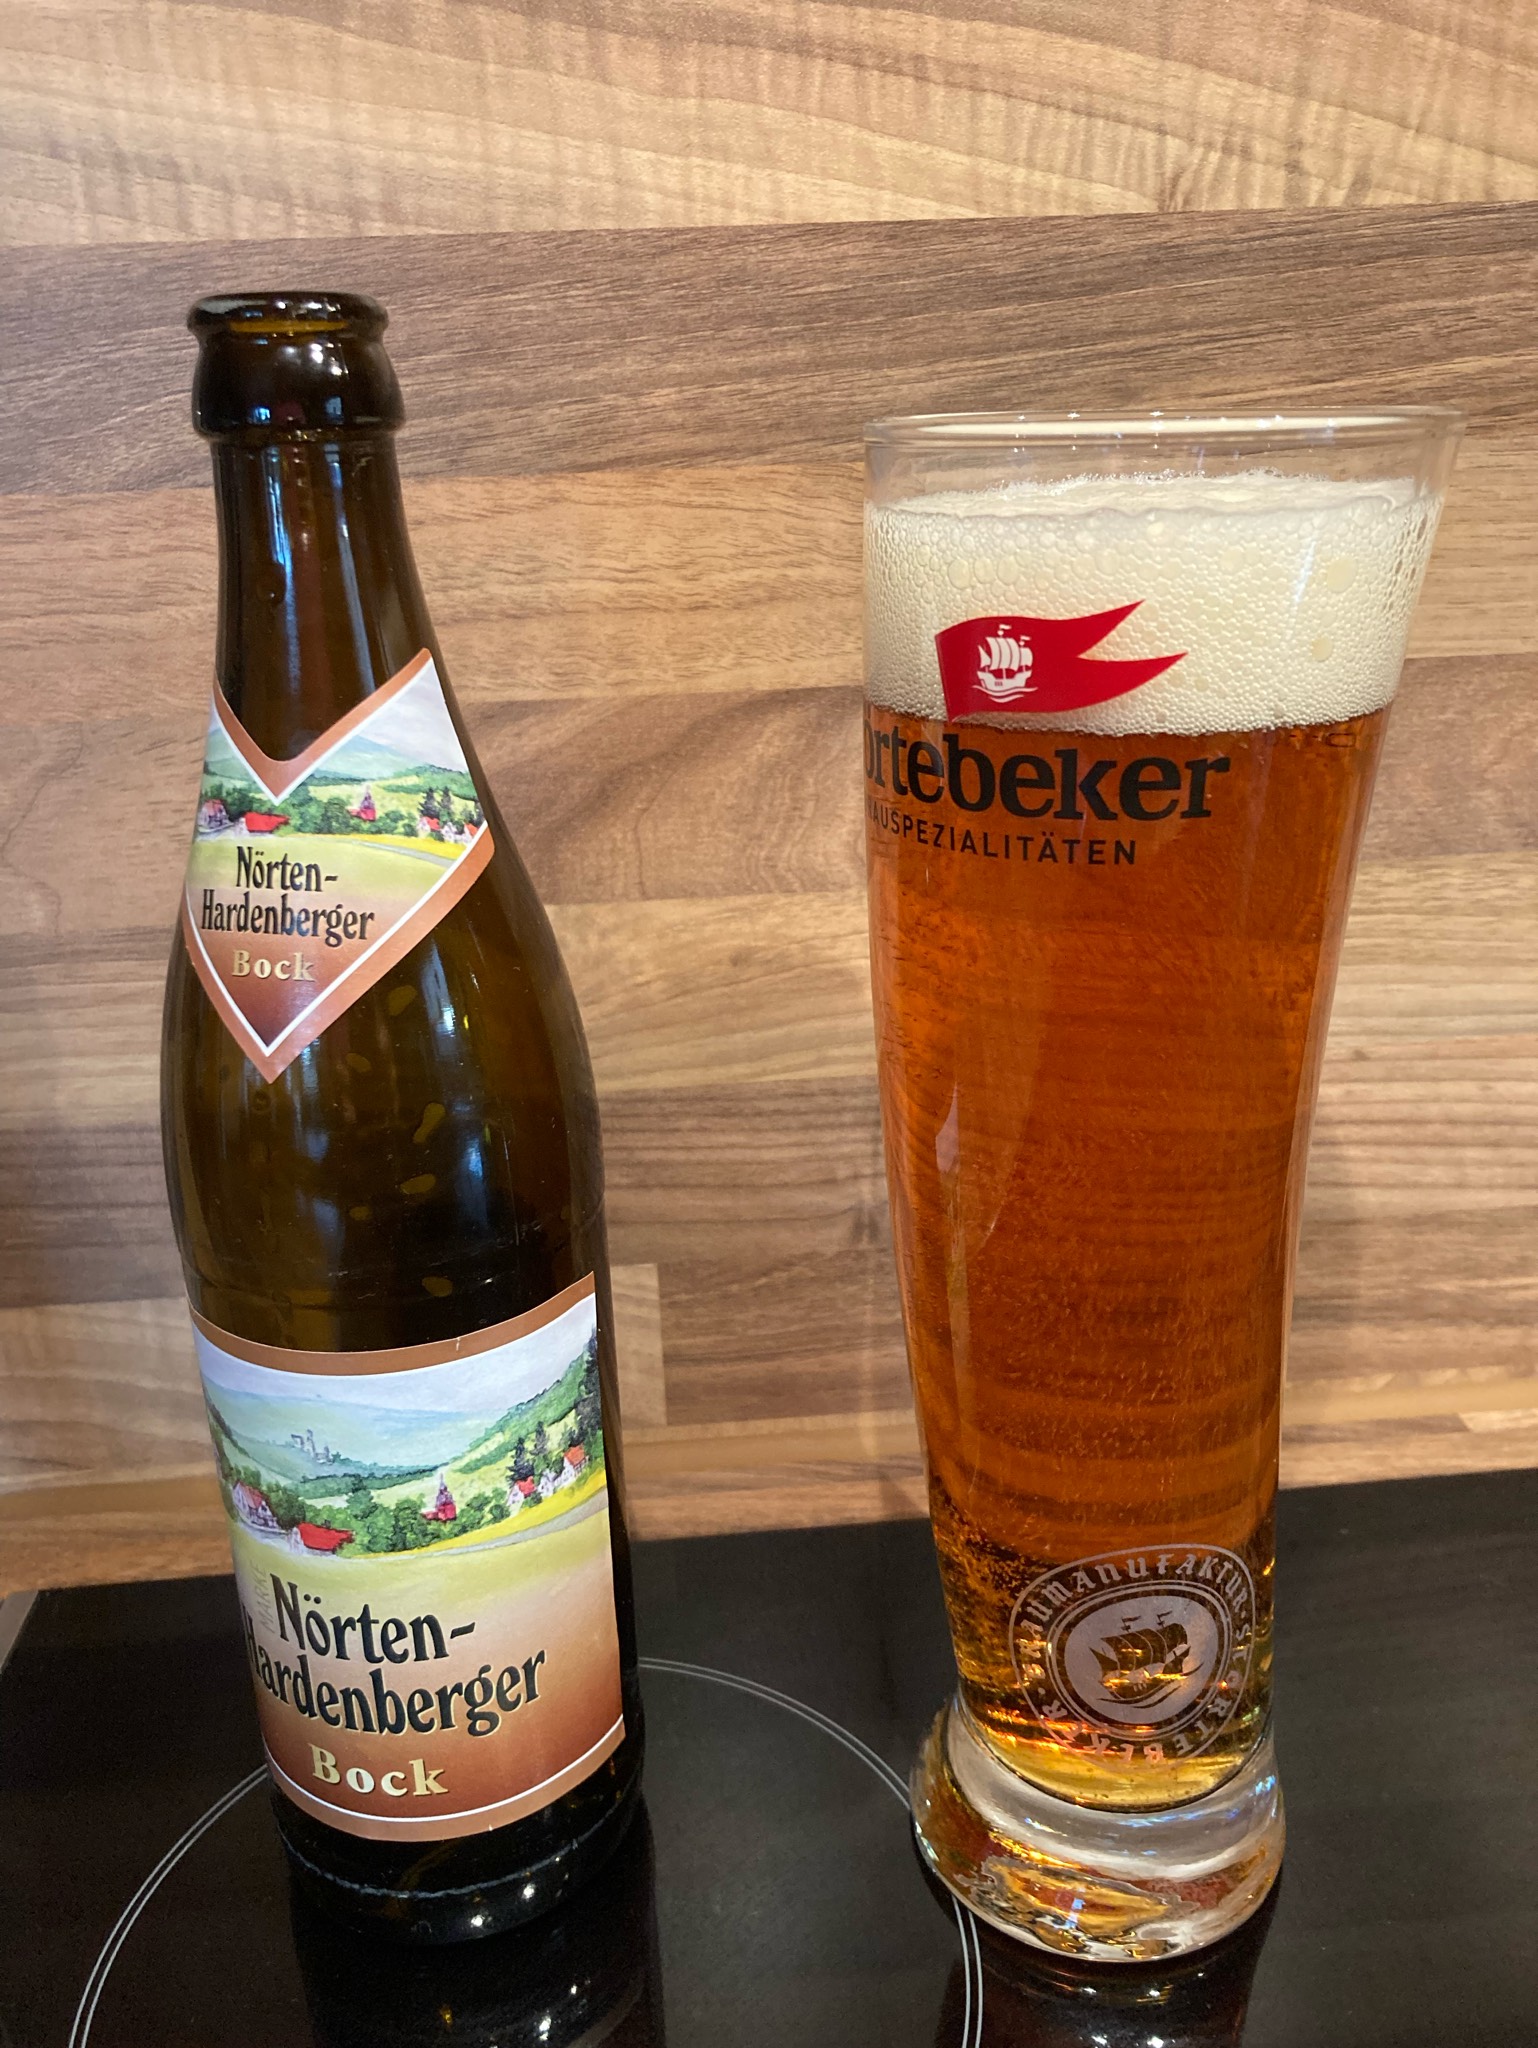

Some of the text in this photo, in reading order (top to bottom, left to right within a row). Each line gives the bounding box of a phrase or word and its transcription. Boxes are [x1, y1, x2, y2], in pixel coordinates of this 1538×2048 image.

[236, 846, 338, 892] Nörten-
[201, 889, 375, 947] Hardenberger
[232, 950, 315, 982] Bock
[251, 1563, 275, 1633] MARKE
[270, 1573, 476, 1664] Nörten-
[242, 1604, 545, 1737] Hardenberger
[310, 1745, 448, 1796] Bock
